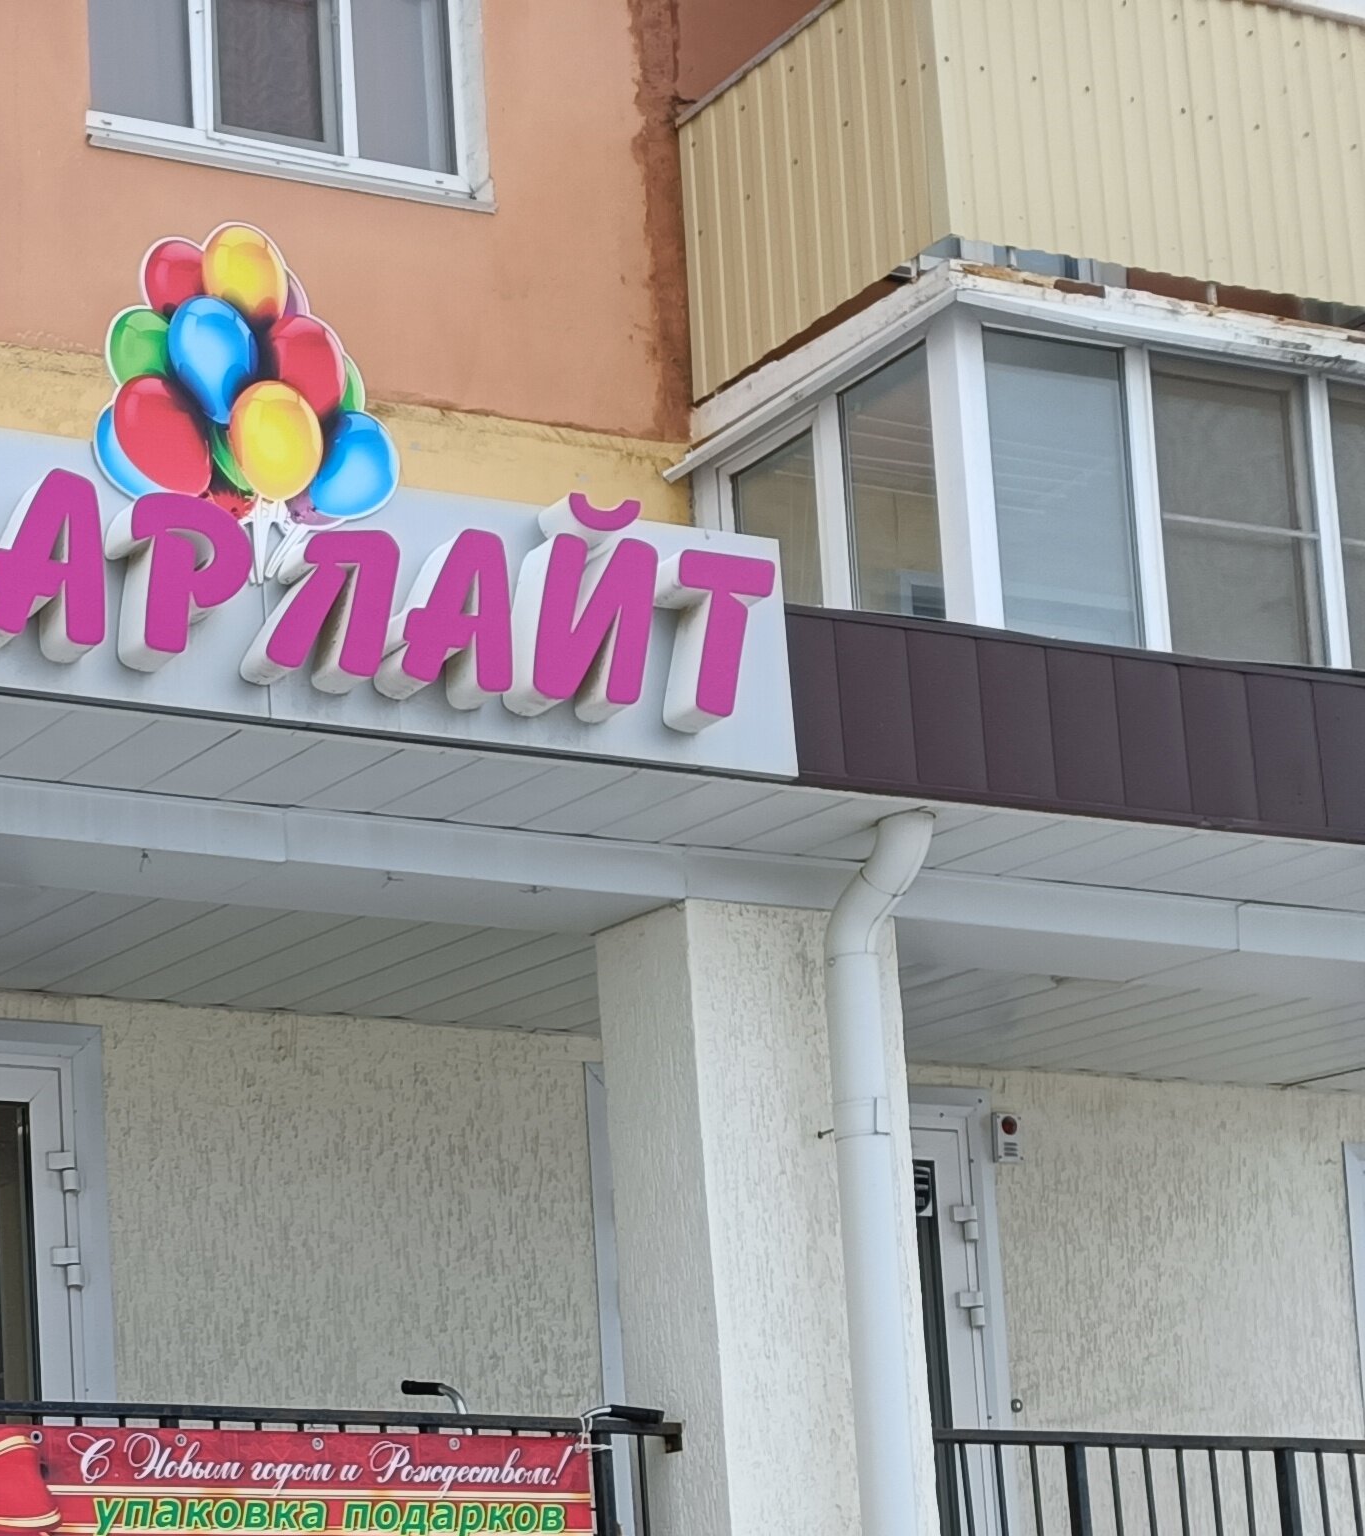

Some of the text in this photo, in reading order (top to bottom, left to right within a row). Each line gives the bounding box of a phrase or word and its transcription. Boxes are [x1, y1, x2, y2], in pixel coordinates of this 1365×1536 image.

[124, 1432, 244, 1482] Новым
[250, 1454, 336, 1496] годом
[340, 1464, 364, 1484] и
[369, 1440, 574, 1498] Рождеством!
